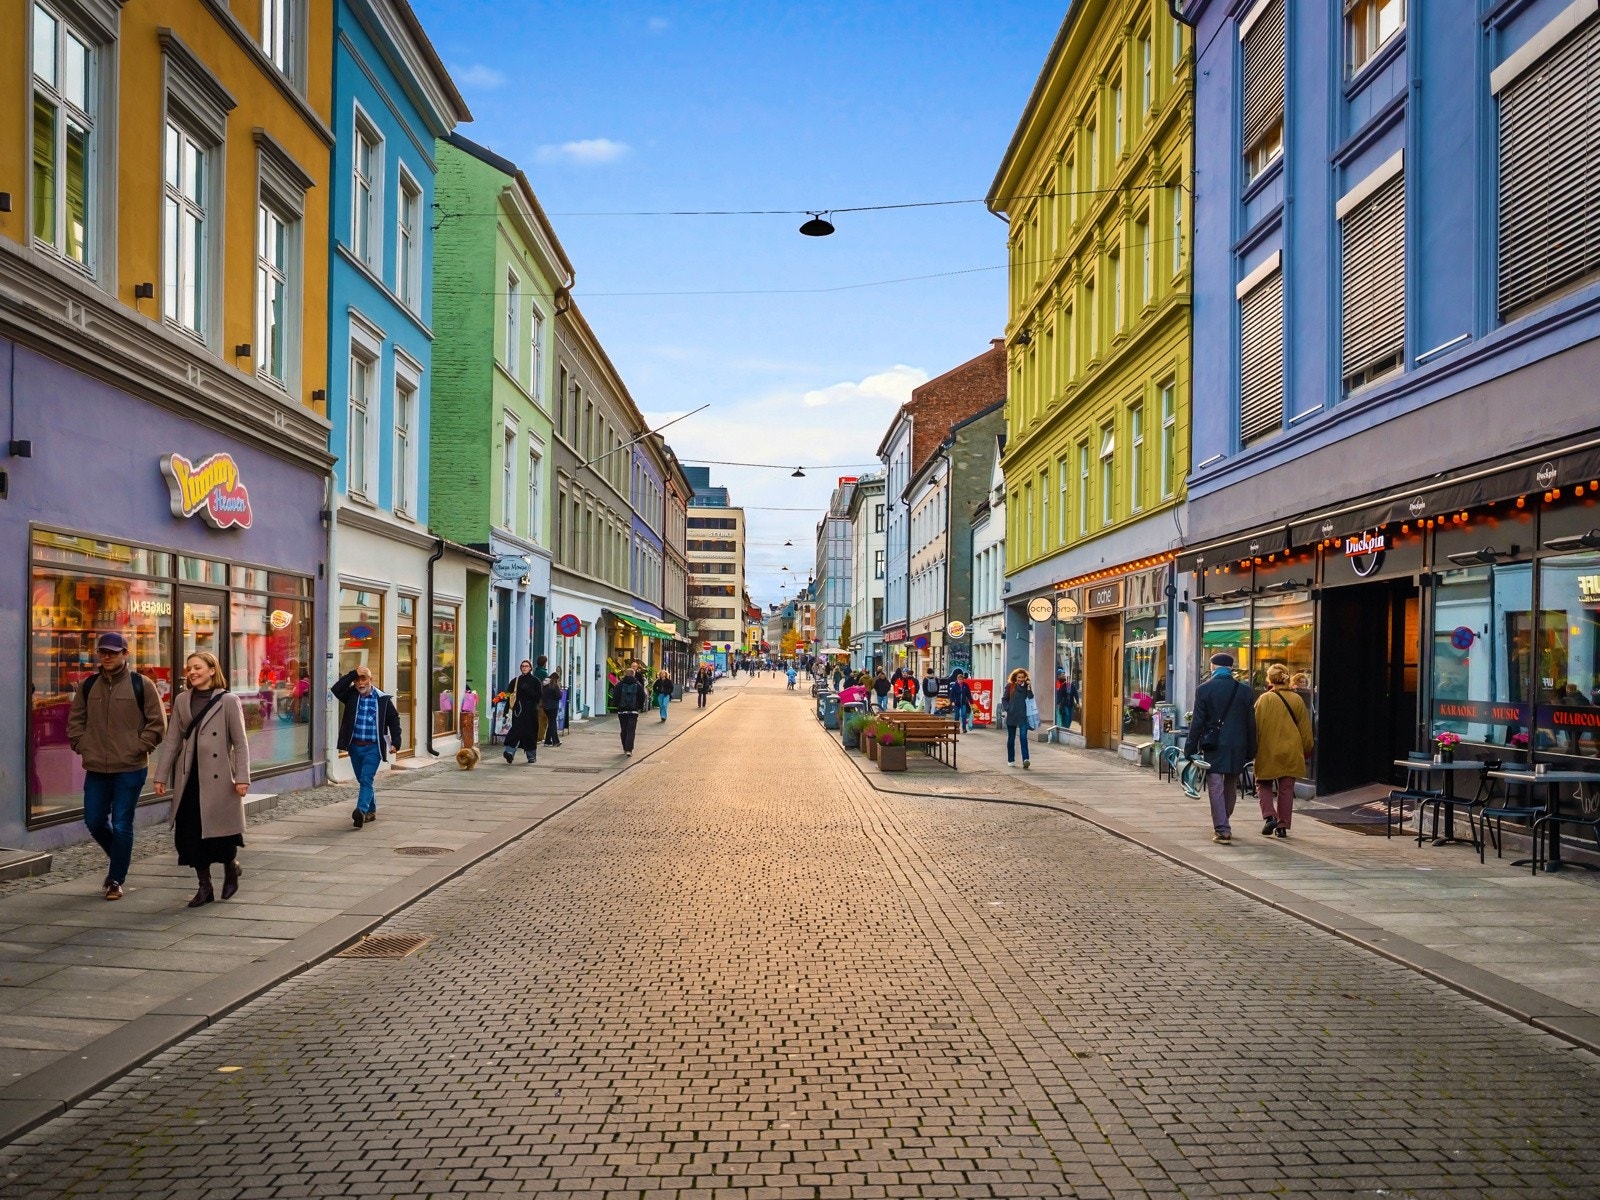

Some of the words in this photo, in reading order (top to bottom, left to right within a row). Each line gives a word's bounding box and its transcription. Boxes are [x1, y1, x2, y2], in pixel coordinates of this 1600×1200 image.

[172, 458, 237, 512] Yummy
[214, 488, 246, 511] Heaven
[1345, 527, 1385, 554] Duckpin
[1440, 704, 1477, 717] KARAOKE
[1492, 708, 1519, 721] MUSIC
